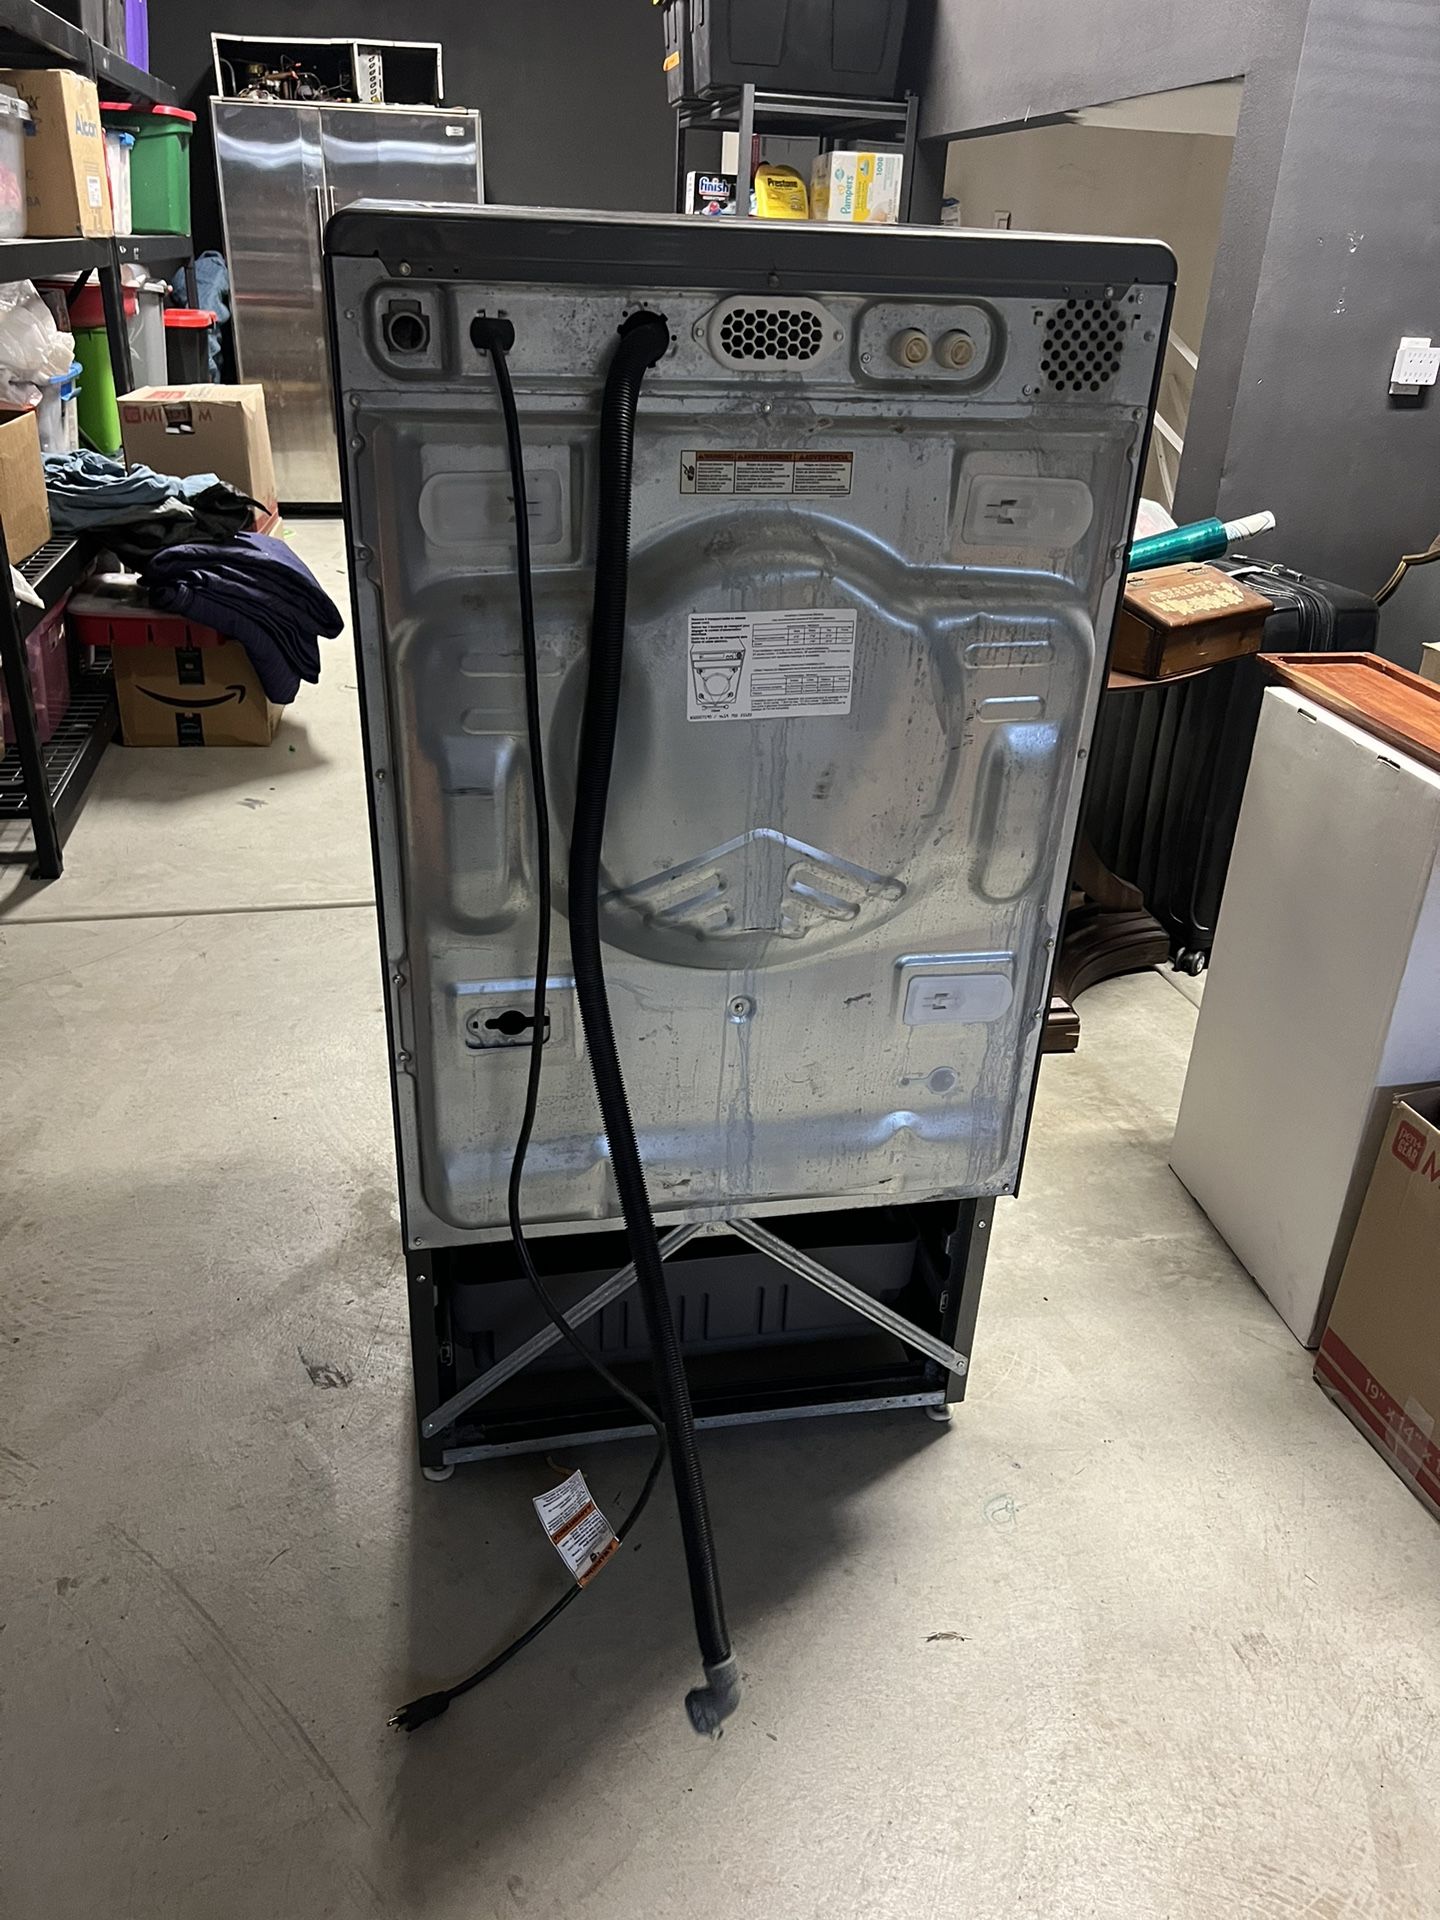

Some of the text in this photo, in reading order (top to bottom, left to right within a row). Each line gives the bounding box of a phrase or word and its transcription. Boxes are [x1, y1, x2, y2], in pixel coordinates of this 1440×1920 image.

[75, 111, 98, 138] Alcon
[700, 178, 729, 193] finish
[840, 175, 854, 215] Pampers
